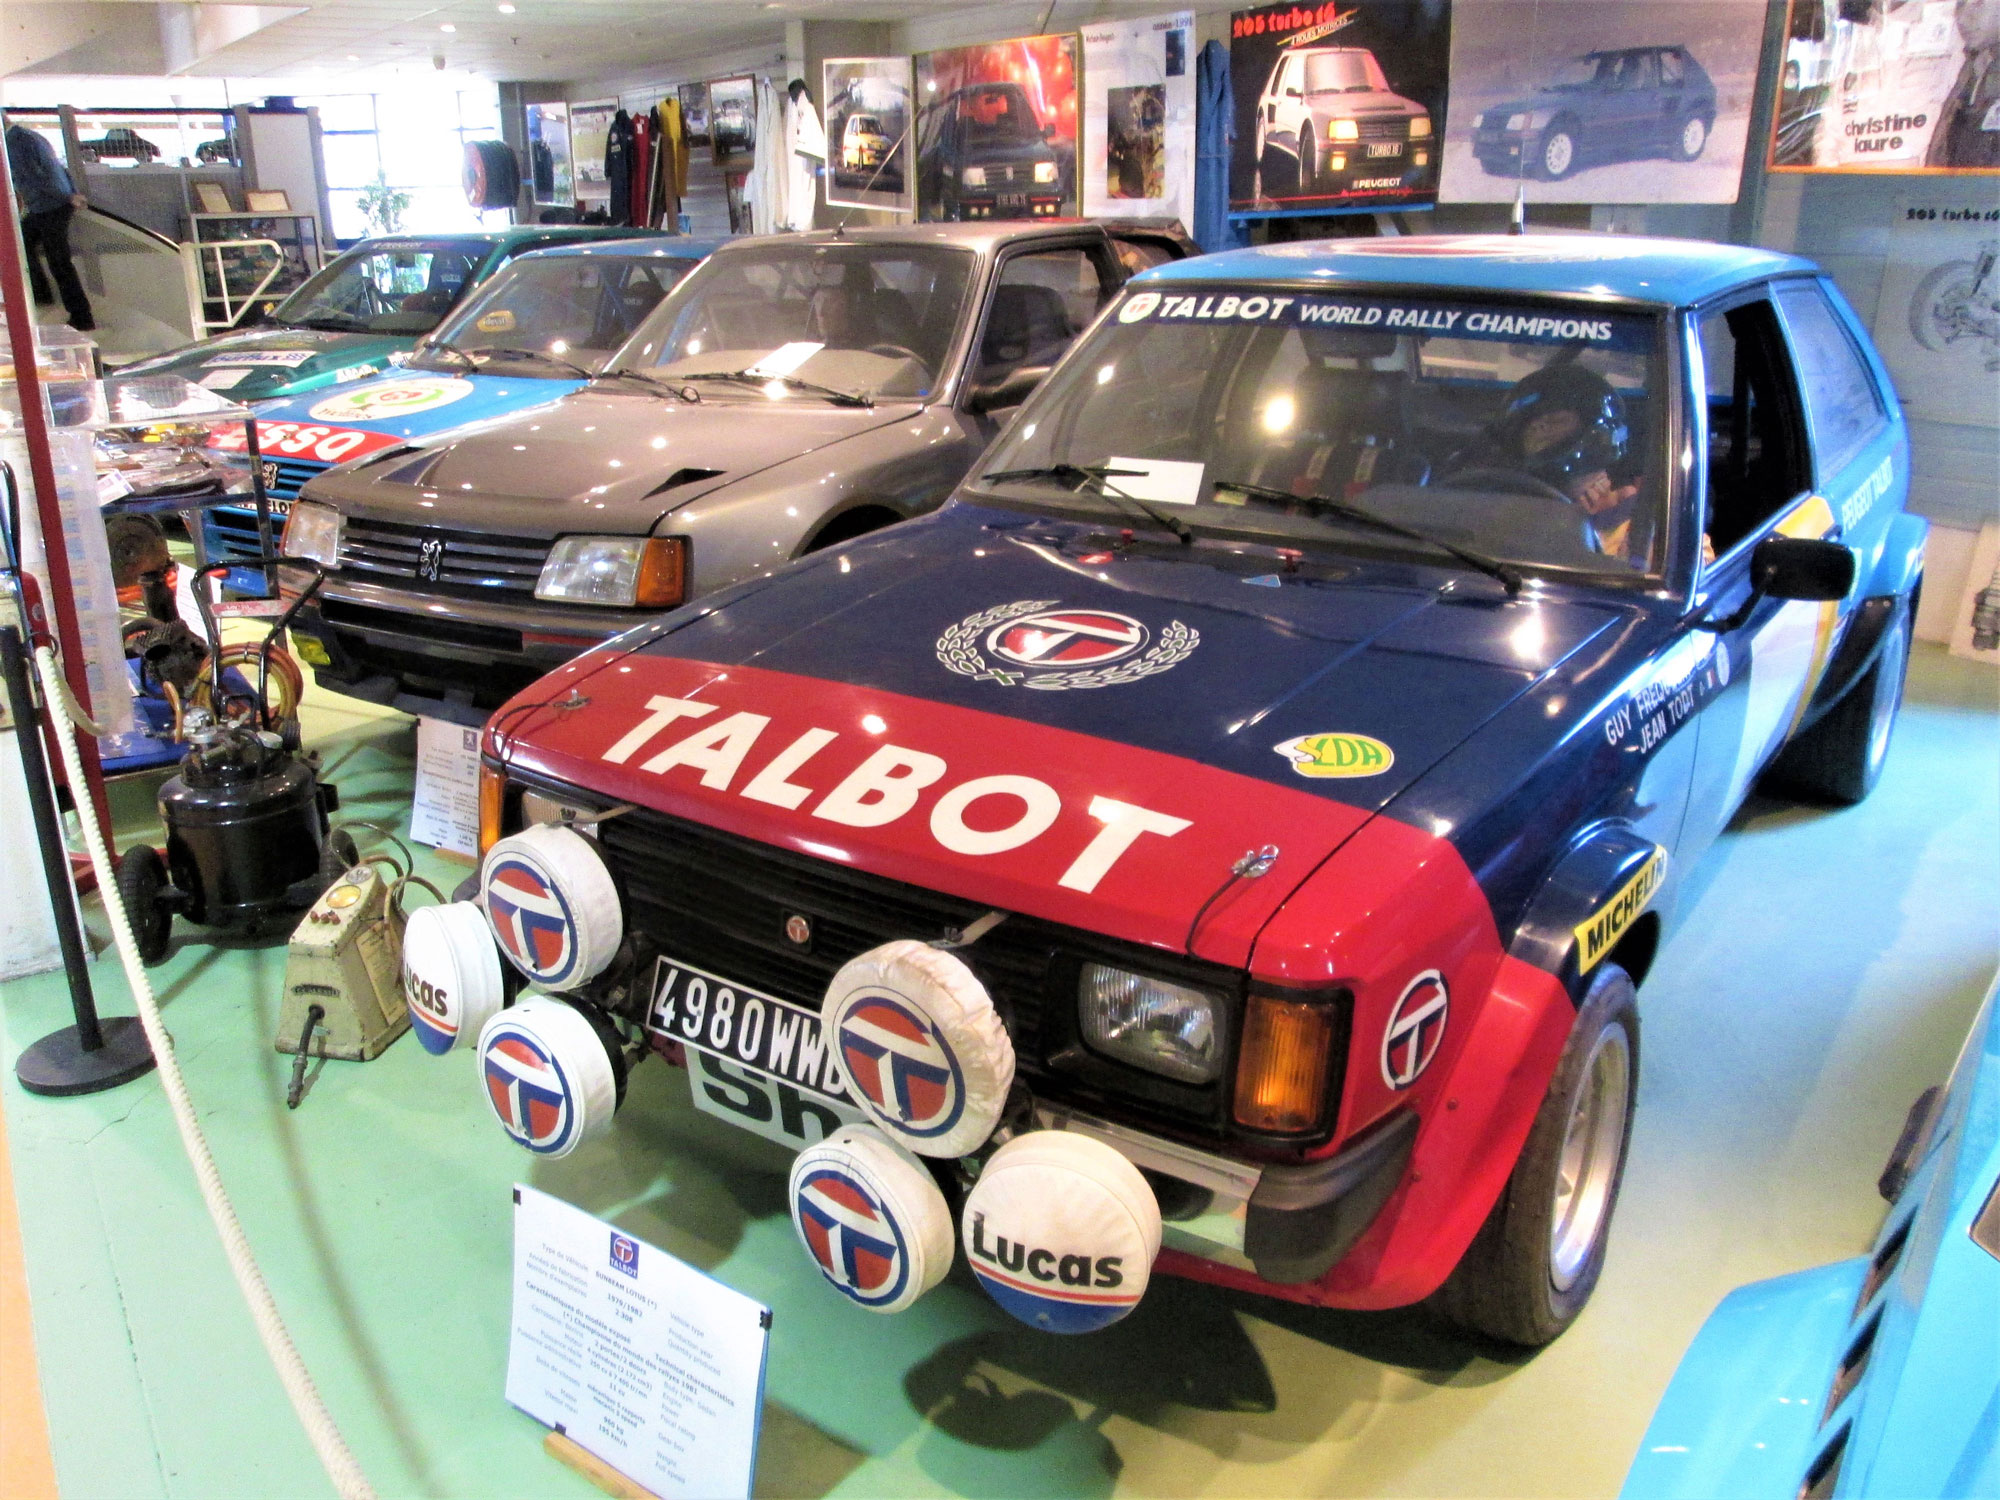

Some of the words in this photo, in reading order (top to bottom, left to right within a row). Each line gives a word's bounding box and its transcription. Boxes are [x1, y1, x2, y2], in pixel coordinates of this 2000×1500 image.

[1268, 6, 1314, 32] turbo
[1844, 112, 1927, 137] christine
[1854, 135, 1903, 154] laure
[1359, 177, 1402, 189] PEUGEOT
[1160, 296, 1294, 321] TALBOT
[1300, 303, 1382, 326] WORLD
[1386, 308, 1459, 331] RALLY
[1465, 312, 1613, 341] CHAMPIONS
[1605, 704, 1632, 746] GUY
[1640, 710, 1667, 754] JEAN
[1667, 682, 1695, 726] TODT
[601, 694, 1195, 895] TALBOT
[973, 1212, 1125, 1288] Lucas
[610, 1257, 636, 1277] TALBOT
[595, 1270, 624, 1291] SUNBEAM
[625, 1287, 645, 1303] LOTUS
